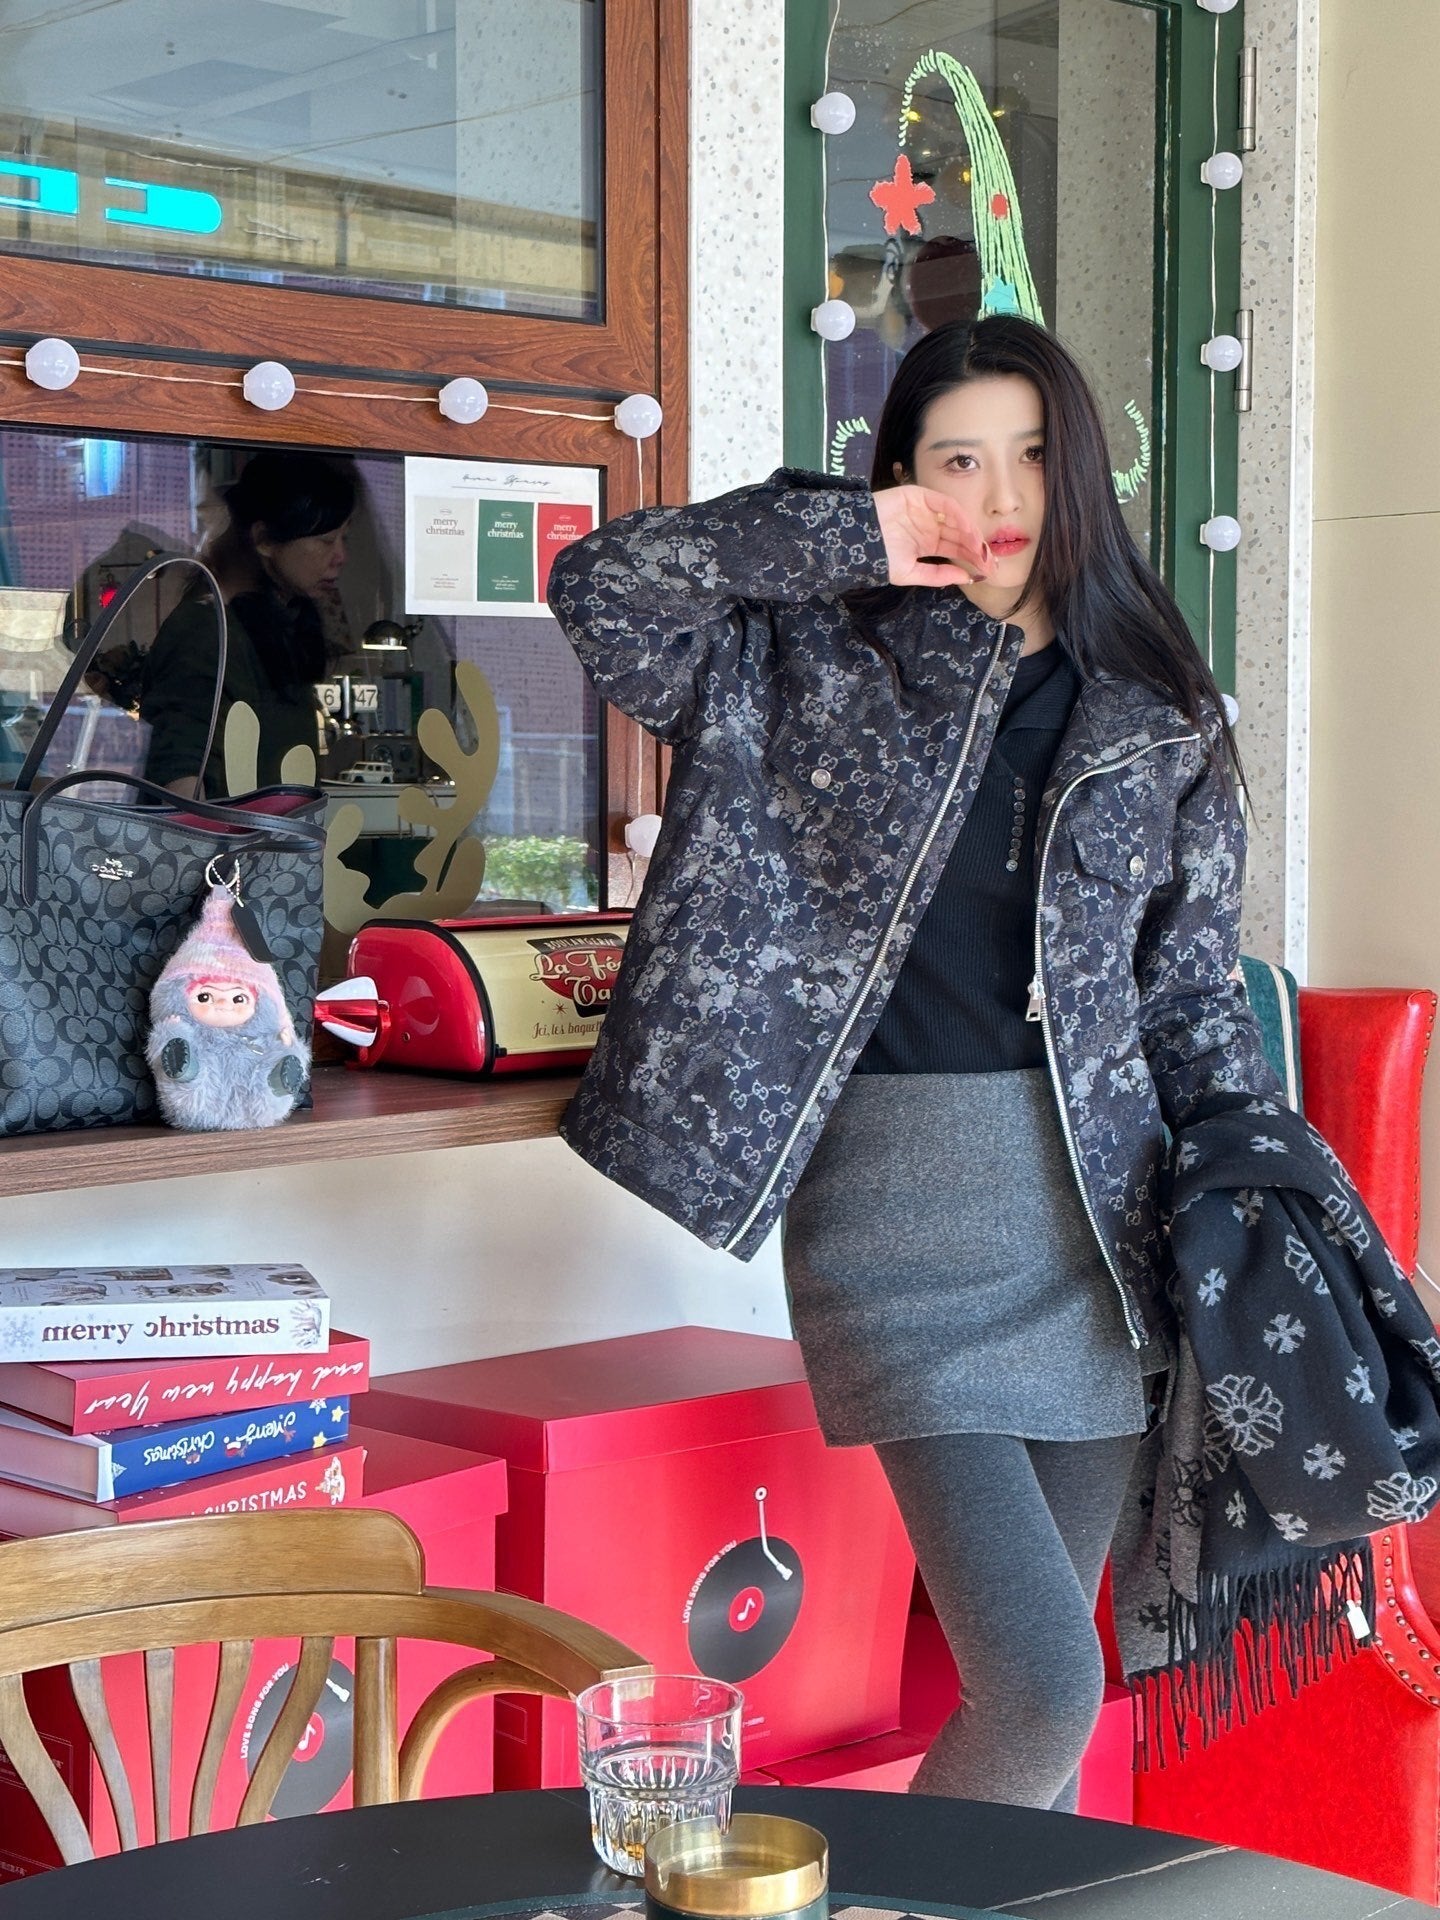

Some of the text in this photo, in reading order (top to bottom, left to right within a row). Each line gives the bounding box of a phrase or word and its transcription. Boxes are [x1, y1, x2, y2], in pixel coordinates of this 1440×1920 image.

[426, 526, 465, 536] christmas
[433, 518, 459, 527] merry
[494, 520, 518, 530] merry
[553, 524, 577, 534] merry
[487, 529, 524, 539] christmas
[355, 689, 376, 707] 47
[91, 864, 134, 878] COACH
[529, 950, 622, 981] La Fé
[564, 975, 612, 1007] Ta
[567, 1020, 603, 1036] baguet
[42, 1314, 280, 1345] merry christmas
[226, 1362, 303, 1397] happy
[312, 1361, 365, 1390] and
[162, 1381, 215, 1401] new
[143, 1411, 297, 1466] Merry Christmas
[681, 1539, 738, 1624] LOVE SONG FOR YOU
[240, 1662, 290, 1759] LOVE SONG FOR YOU
